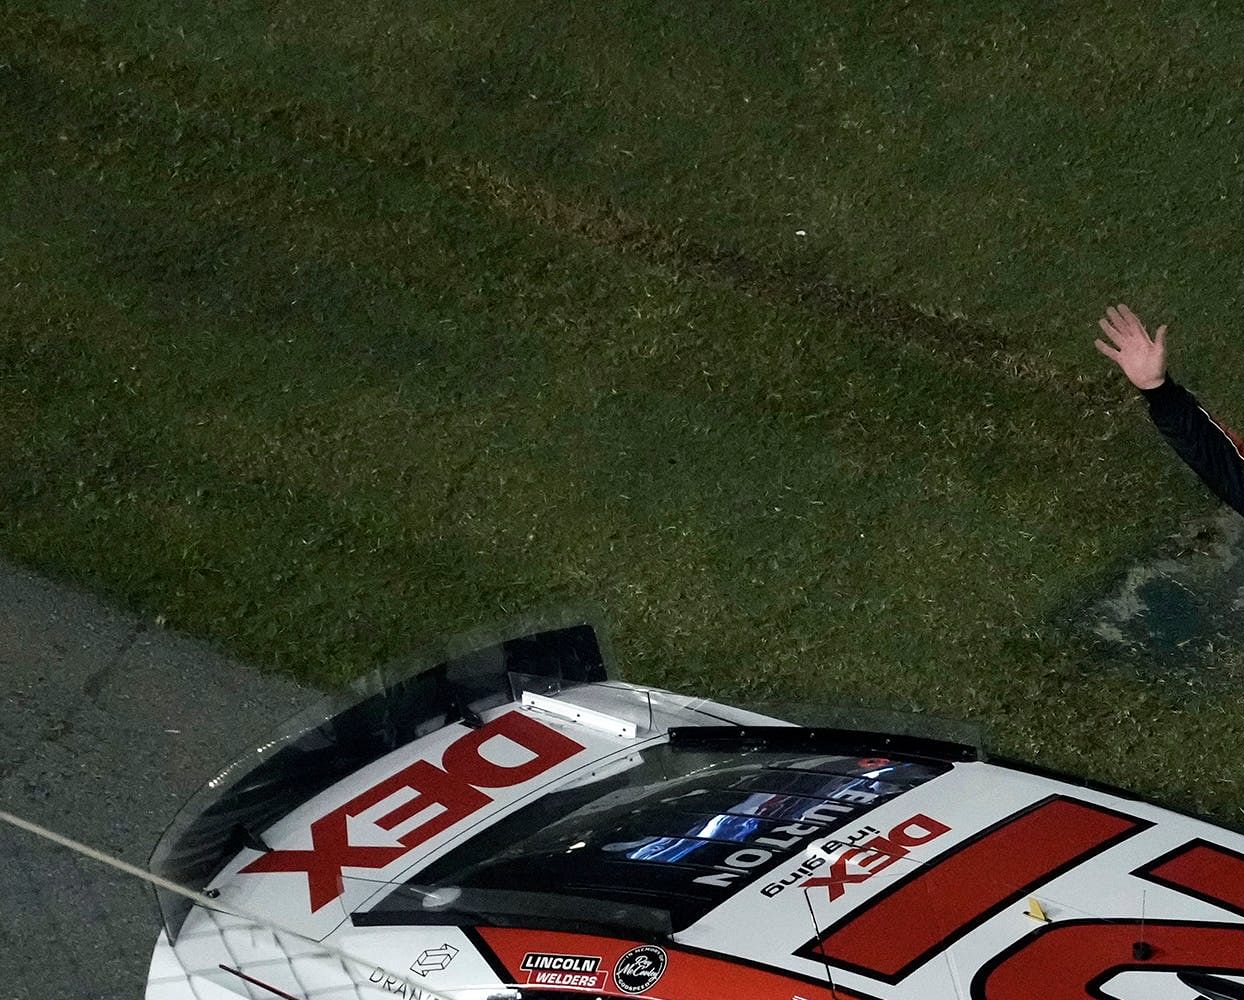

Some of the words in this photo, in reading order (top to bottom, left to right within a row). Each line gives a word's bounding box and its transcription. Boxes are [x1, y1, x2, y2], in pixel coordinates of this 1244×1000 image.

[238, 710, 585, 913] DEX
[693, 788, 880, 889] BURTON
[760, 825, 881, 899] imaging
[800, 813, 951, 902] DEX
[525, 955, 596, 972] LINCOLN
[536, 972, 598, 987] WELDERS
